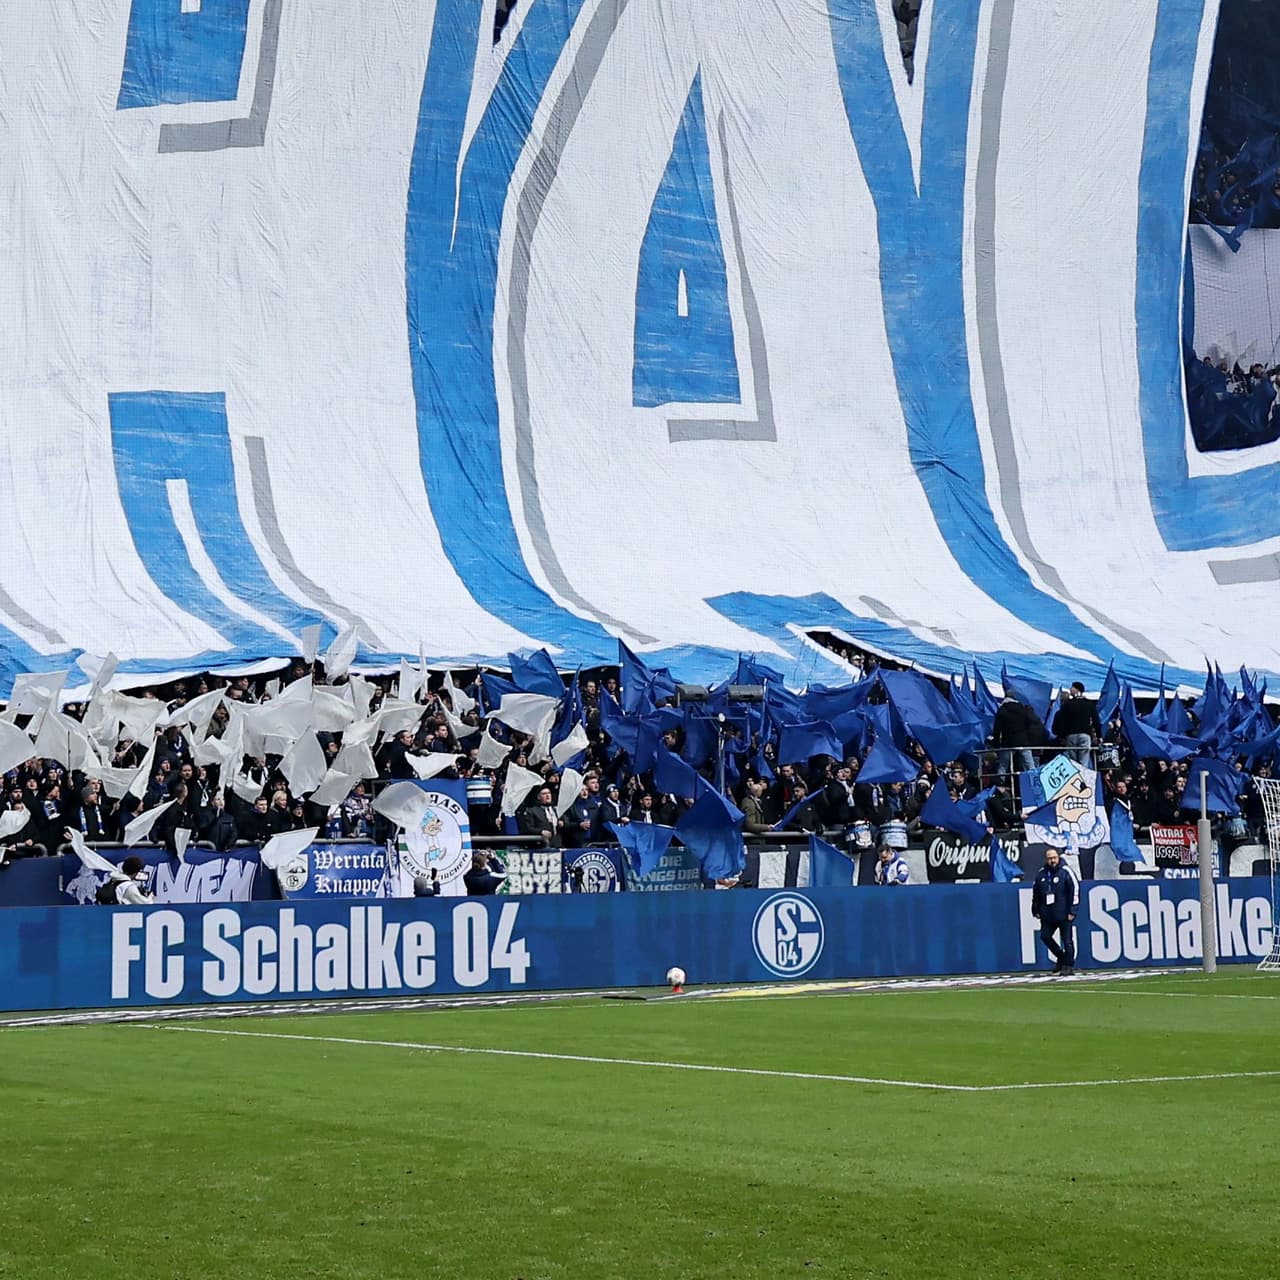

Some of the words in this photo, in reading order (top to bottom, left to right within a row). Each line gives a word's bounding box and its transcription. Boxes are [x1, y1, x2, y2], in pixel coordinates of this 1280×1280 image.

[1153, 829, 1184, 838] ULTRAS
[507, 851, 562, 874] BLUE
[1156, 845, 1180, 859] 1994
[402, 853, 469, 882] GELSENIRCHEN
[313, 873, 381, 896] Knappe
[508, 873, 562, 895] BOYZ
[1088, 883, 1273, 963] Schake
[111, 911, 185, 999] FC
[202, 904, 436, 996] Schalke
[452, 901, 531, 987] 04
